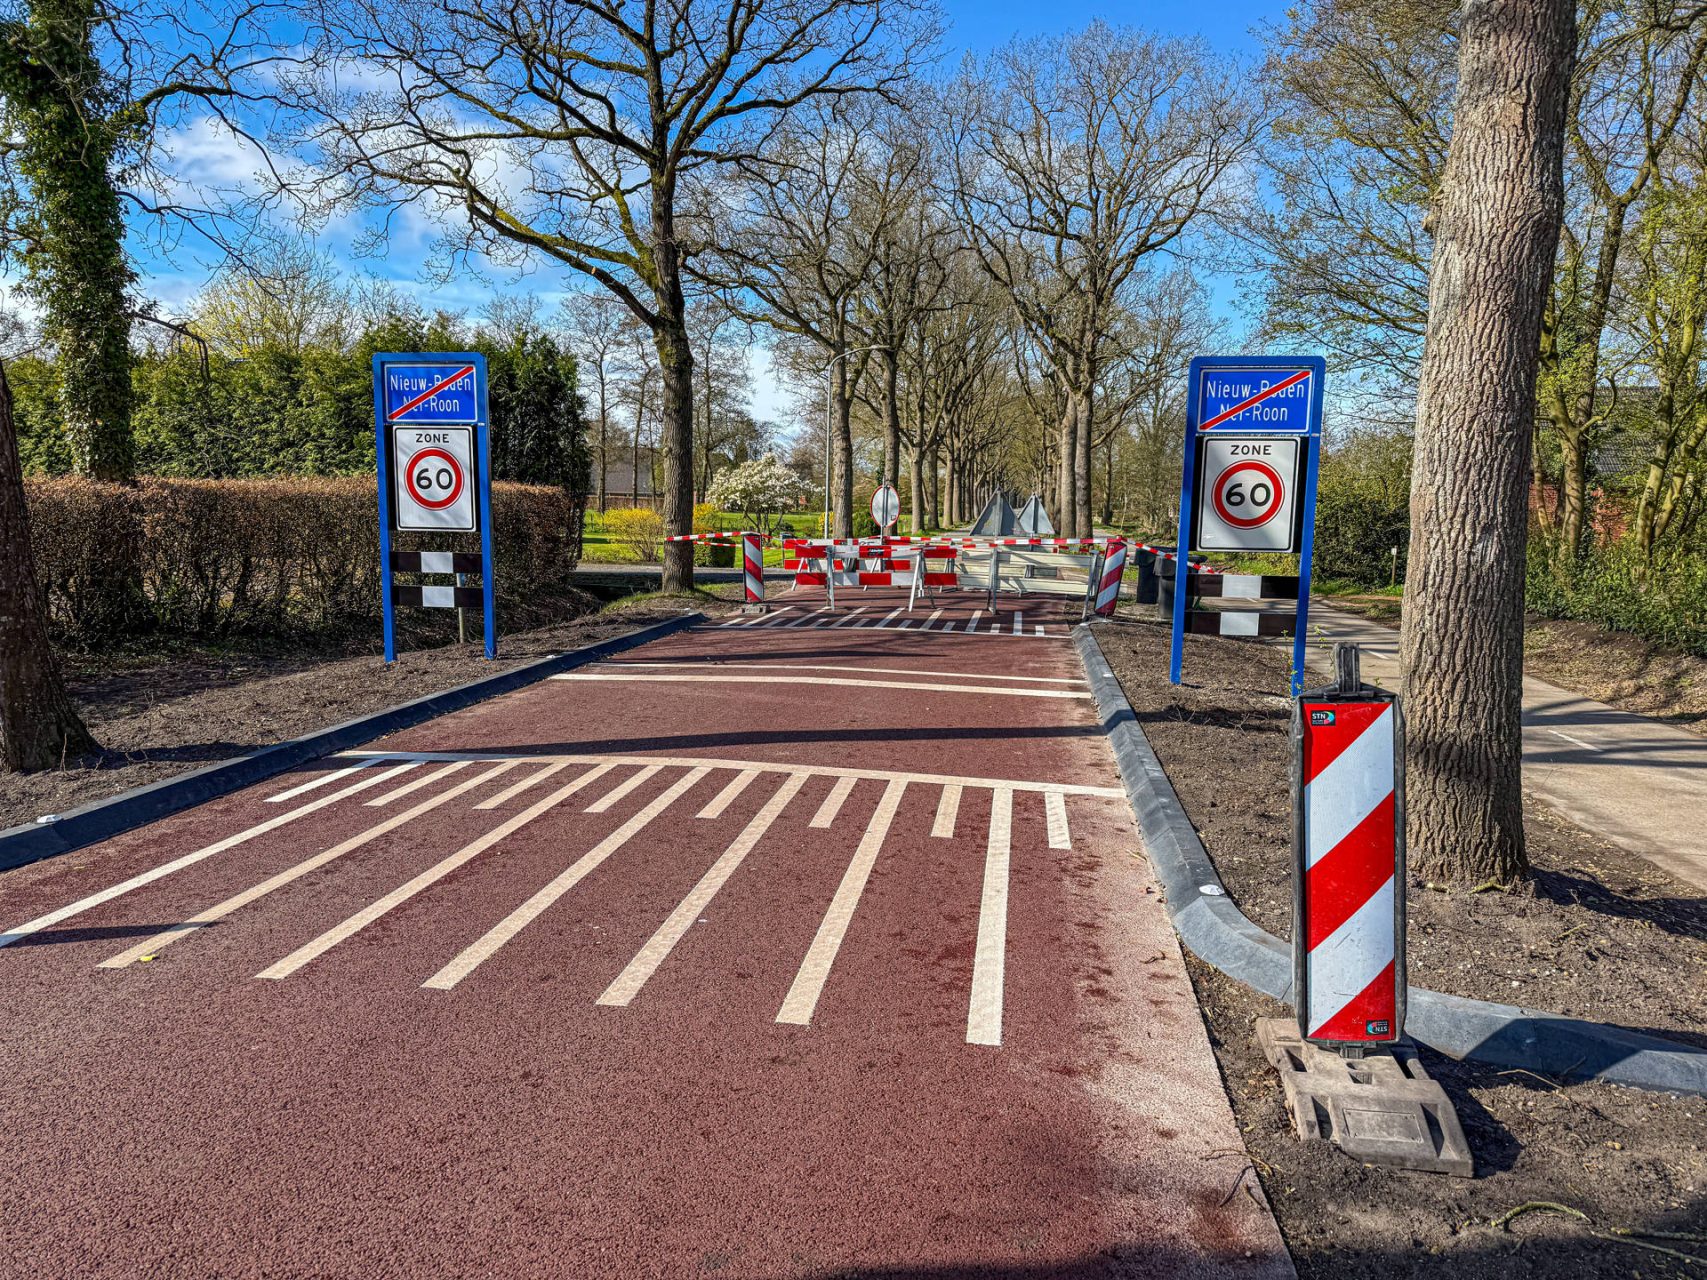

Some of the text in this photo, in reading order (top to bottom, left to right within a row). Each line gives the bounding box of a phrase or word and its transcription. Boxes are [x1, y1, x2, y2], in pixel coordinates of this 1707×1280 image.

[390, 374, 471, 391] Nieuw-Ren
[1206, 380, 1305, 398] Nieuw-Ren
[415, 433, 450, 443] ZONE
[1230, 444, 1272, 456] ZONE
[416, 468, 453, 490] 60
[1225, 483, 1271, 507] 60
